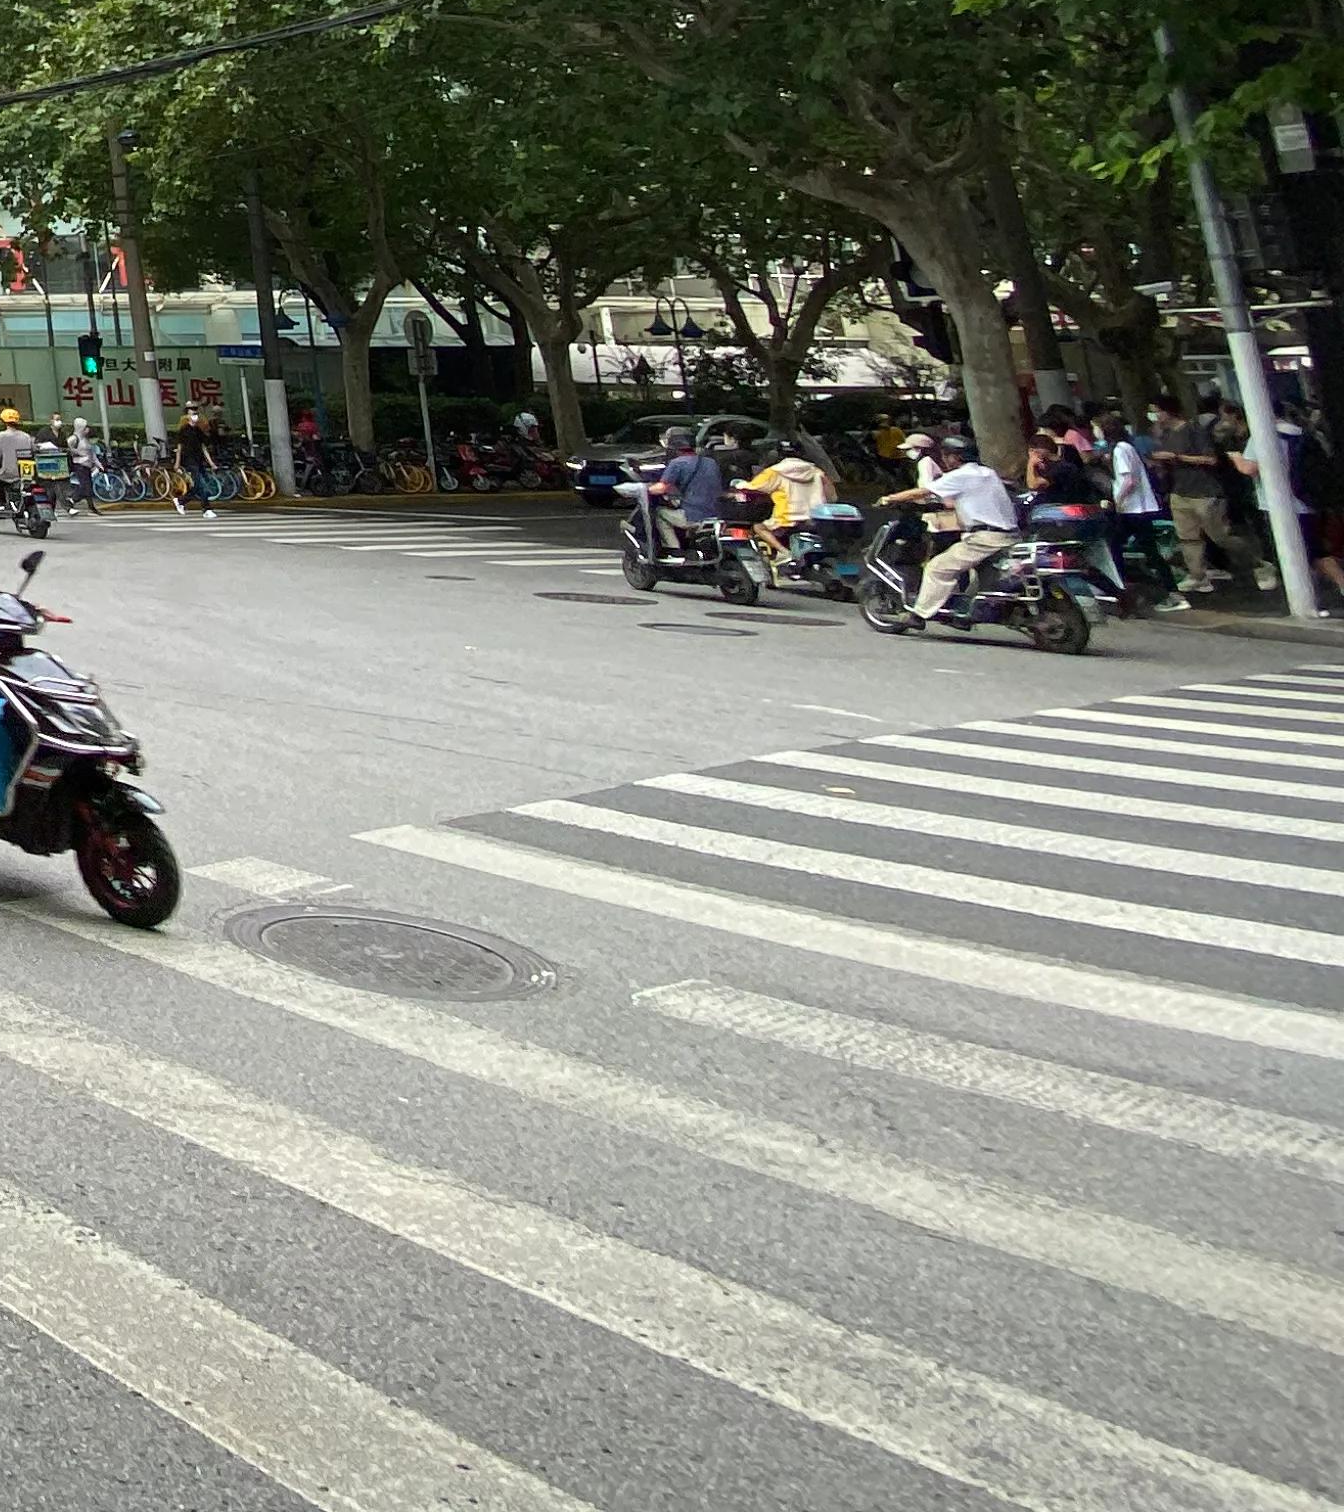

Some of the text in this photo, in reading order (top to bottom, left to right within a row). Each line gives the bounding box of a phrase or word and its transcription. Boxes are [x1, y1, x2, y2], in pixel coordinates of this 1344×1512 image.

[104, 357, 192, 372] 旦大附属
[63, 376, 225, 408] 华山医院
